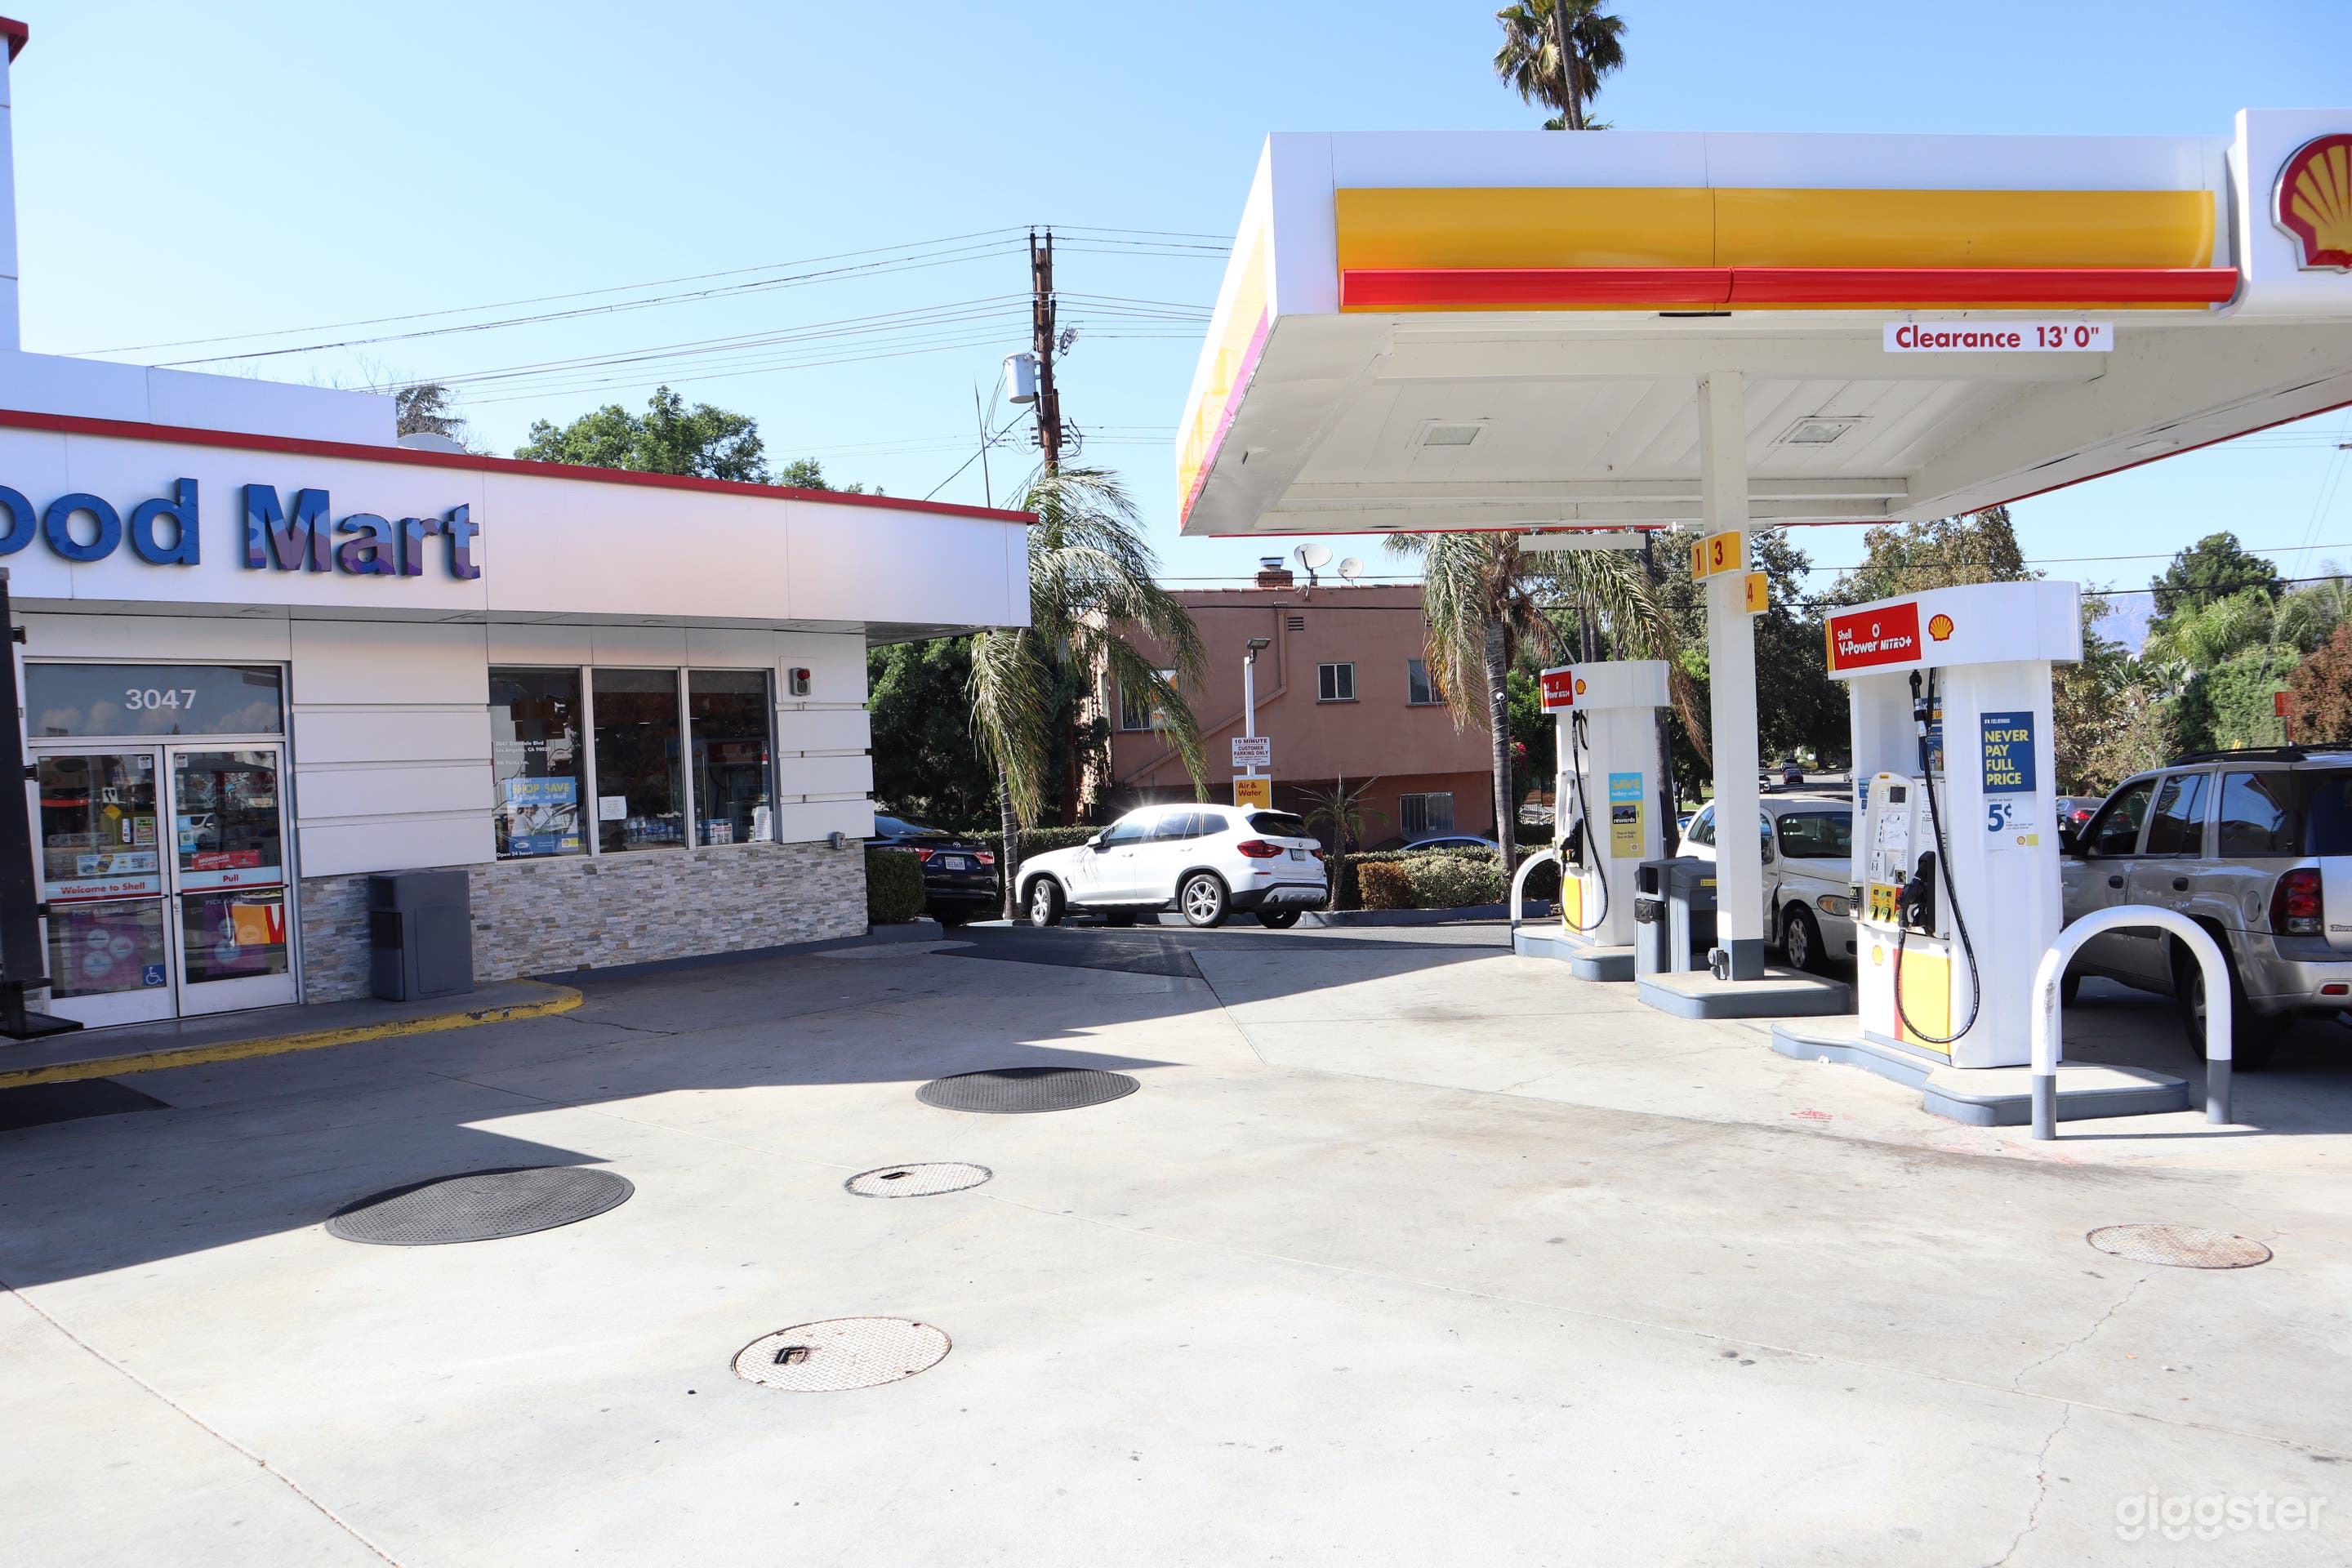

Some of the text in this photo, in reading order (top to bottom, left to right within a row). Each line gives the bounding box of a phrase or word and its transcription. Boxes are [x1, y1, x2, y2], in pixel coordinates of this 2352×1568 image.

[1895, 325, 2021, 348] Clearance
[2037, 326, 2068, 348] 13'
[243, 483, 480, 581] Mart
[1696, 548, 1700, 571] 1
[1714, 541, 1723, 566] 3
[1748, 583, 1753, 603] 4
[1838, 628, 1852, 641] Shell
[1838, 640, 1877, 656] V-Power
[125, 688, 197, 710] 3047
[1984, 729, 2029, 742] NEVER
[1985, 745, 2009, 756] PAY
[1986, 759, 2015, 771] FULL
[1612, 778, 1641, 790] SAVE
[1986, 772, 2022, 786] PRICE
[512, 782, 569, 794] SHOP SAVE
[1988, 804, 2012, 832] 5¢
[198, 853, 229, 863] MONDAYS
[223, 874, 238, 882] Pull
[60, 885, 106, 895] Welcome
[122, 882, 145, 891] Shell
[72, 908, 91, 916] PICK
[100, 906, 124, 915] GAME
